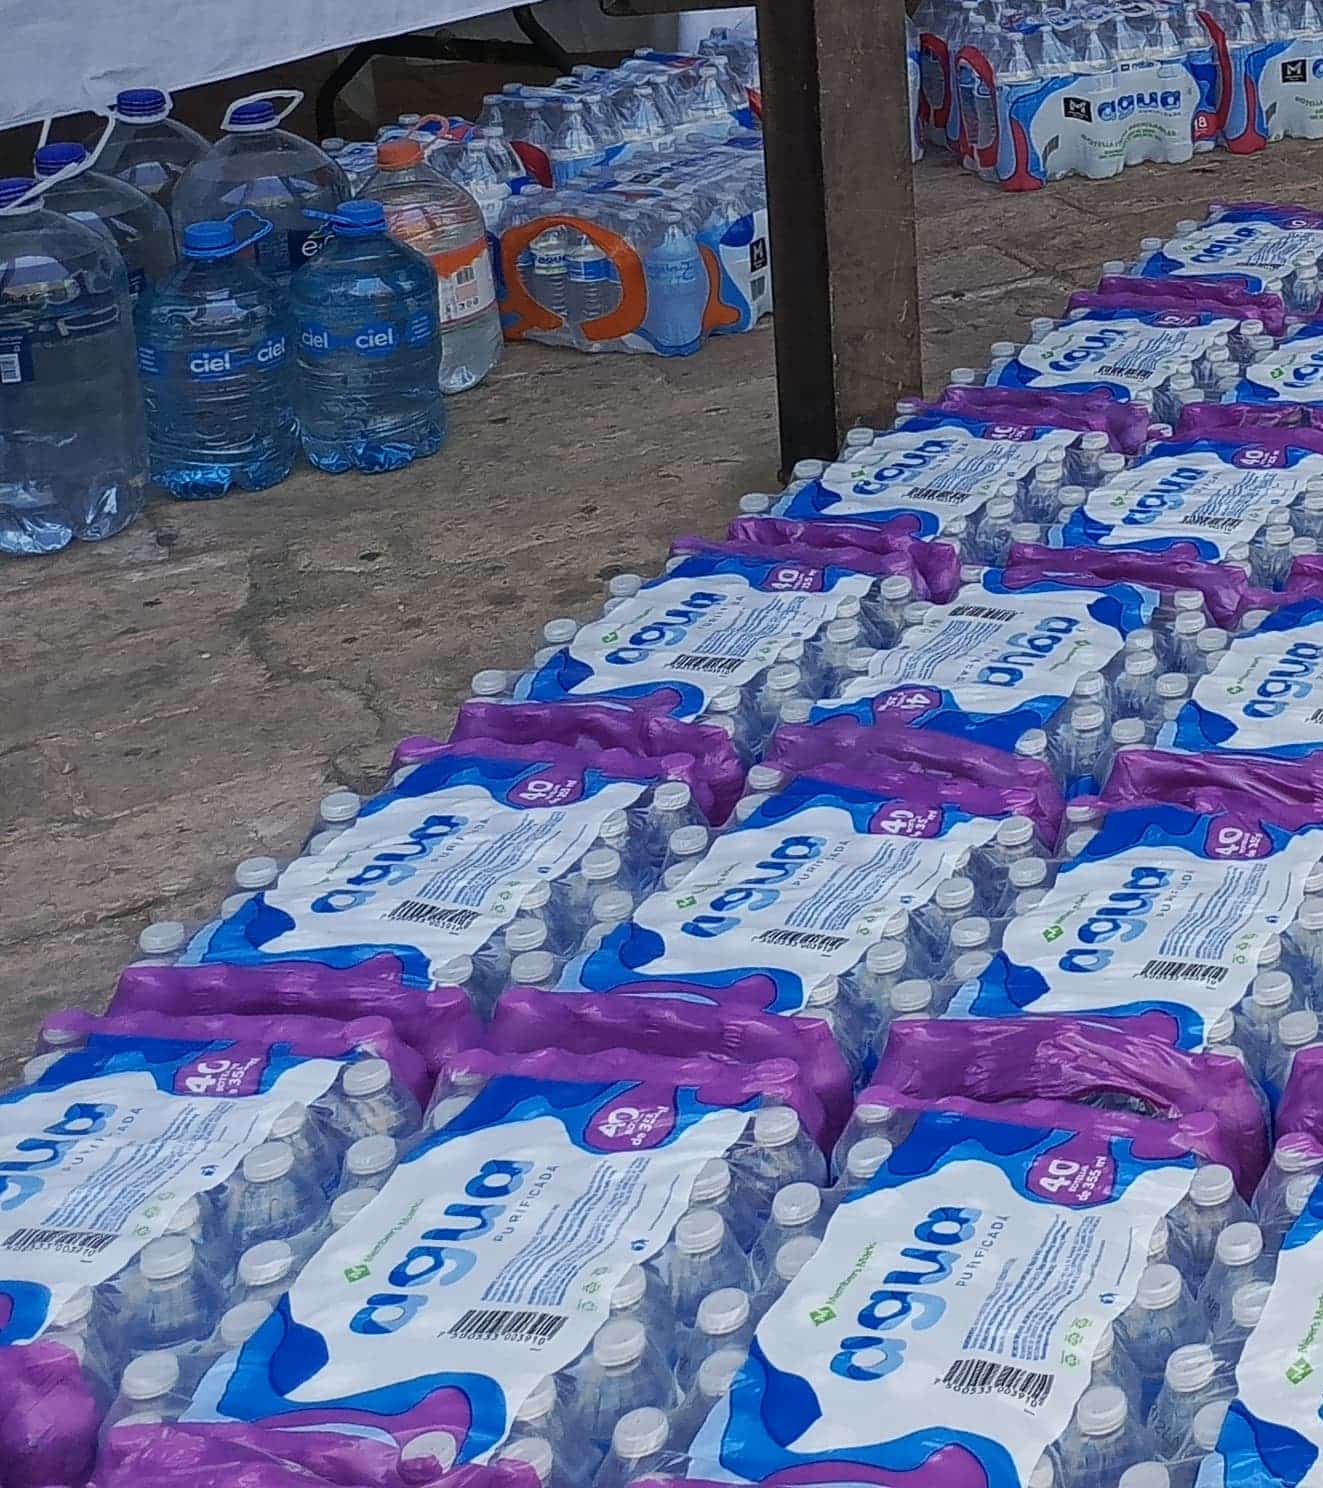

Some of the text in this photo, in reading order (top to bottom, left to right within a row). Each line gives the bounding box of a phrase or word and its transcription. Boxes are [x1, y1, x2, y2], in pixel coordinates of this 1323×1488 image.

[1097, 90, 1182, 122] agua
[190, 352, 231, 374] ciel
[256, 336, 286, 363] ciel
[356, 327, 394, 349] ciel
[852, 437, 955, 497] agua
[1120, 463, 1207, 527] agua
[603, 590, 729, 666] agua
[976, 615, 1081, 688] agua
[519, 777, 555, 805] 40
[309, 813, 472, 916] agua
[1215, 825, 1245, 858] 40
[679, 833, 829, 940] agua
[1056, 863, 1178, 973] agua
[598, 1106, 640, 1142] 40
[492, 1163, 561, 1244] PURIFICADA
[1038, 1158, 1081, 1196] 40
[348, 1157, 536, 1336] agua
[954, 1213, 1011, 1289] PURIFICADA
[828, 1204, 983, 1383] agua
